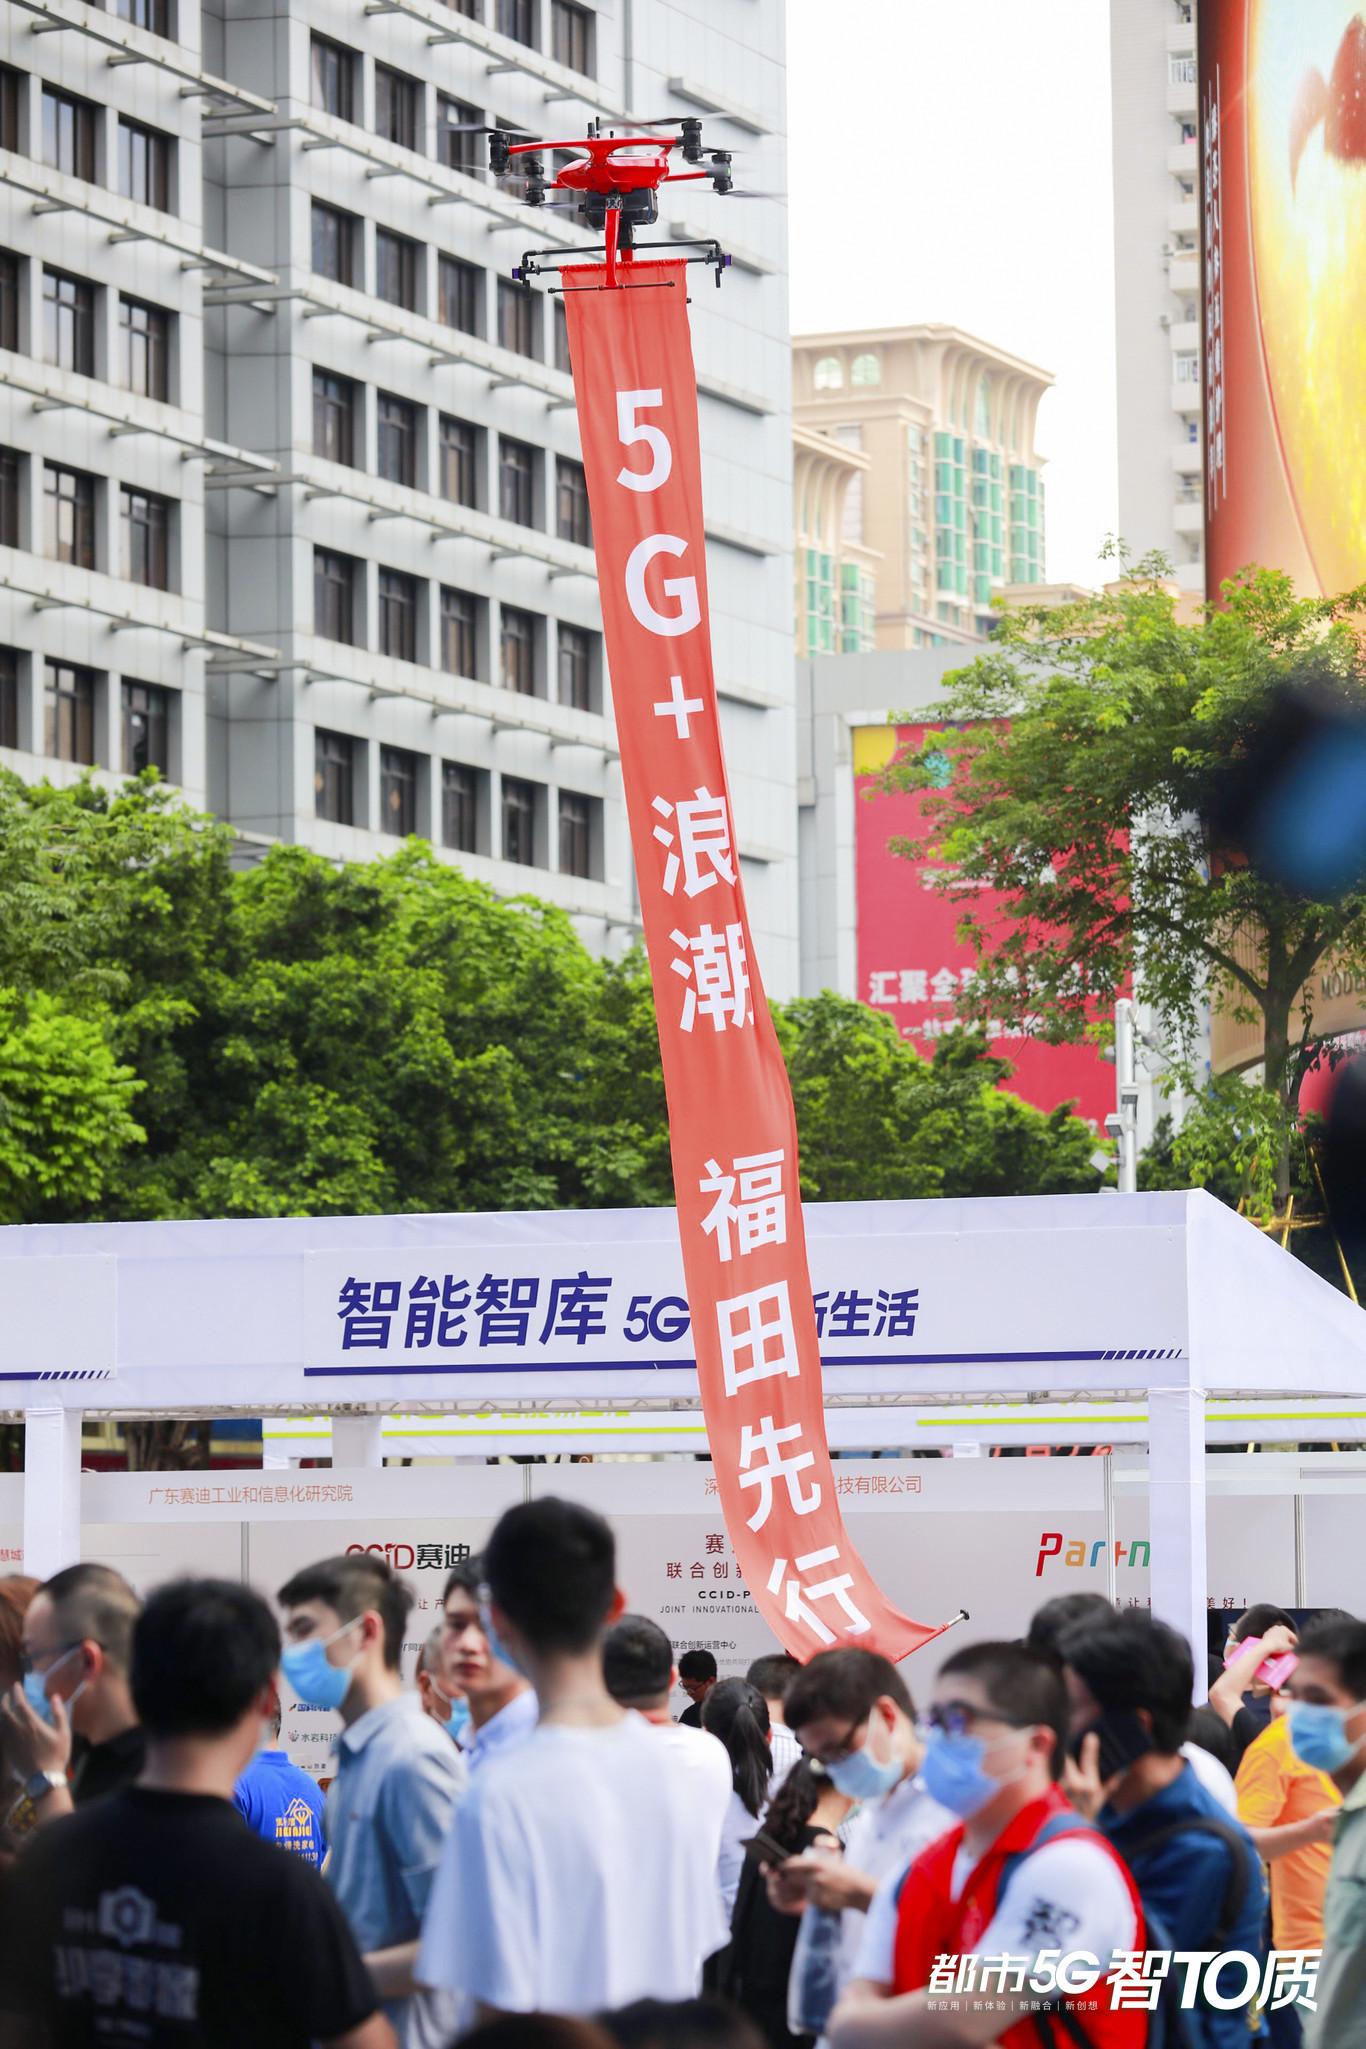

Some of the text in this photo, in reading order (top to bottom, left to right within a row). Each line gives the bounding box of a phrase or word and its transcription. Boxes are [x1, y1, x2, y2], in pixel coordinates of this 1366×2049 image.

[337, 1270, 613, 1350] 智能智库
[623, 1296, 691, 1342] 5G
[700, 1147, 872, 1645] 福田先行
[149, 1484, 353, 1505] 广东赛迪工业和信息化研究院
[835, 1475, 921, 1495] 技有限公司
[698, 1590, 751, 1600] CCID-P
[660, 1605, 760, 1614] JOINT INNOVATIONAL
